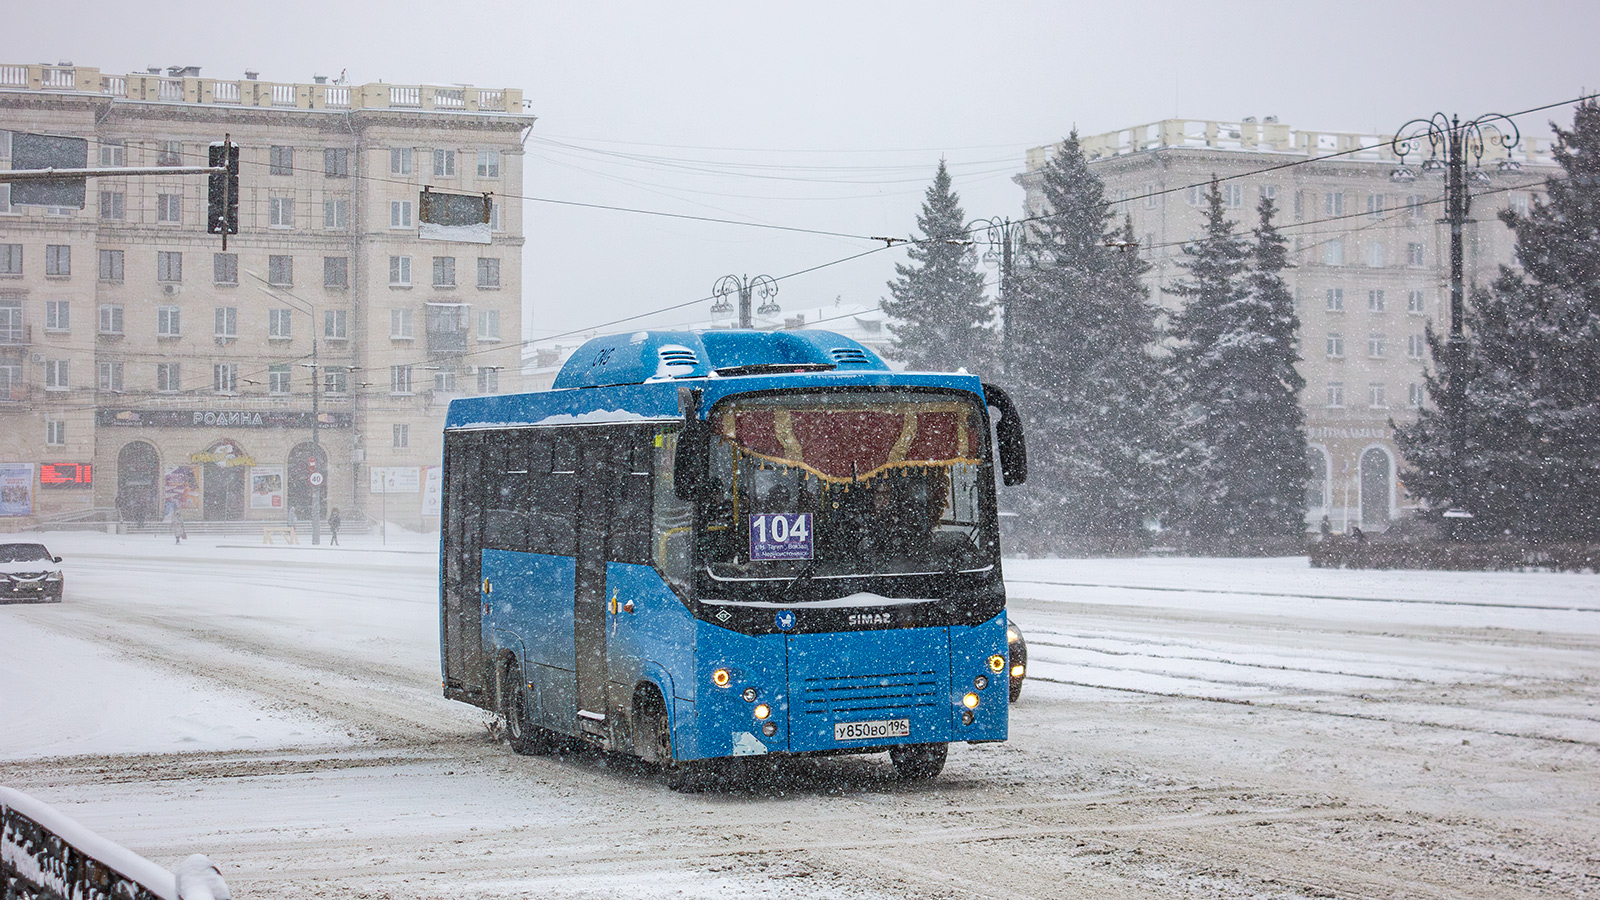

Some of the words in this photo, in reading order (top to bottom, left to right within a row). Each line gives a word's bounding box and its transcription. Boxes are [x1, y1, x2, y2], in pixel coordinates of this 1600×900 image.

[592, 347, 615, 367] CNG
[193, 412, 263, 426] РОДИНА
[753, 514, 809, 543] 104
[848, 612, 891, 626] SIMAZ
[888, 720, 908, 732] 196
